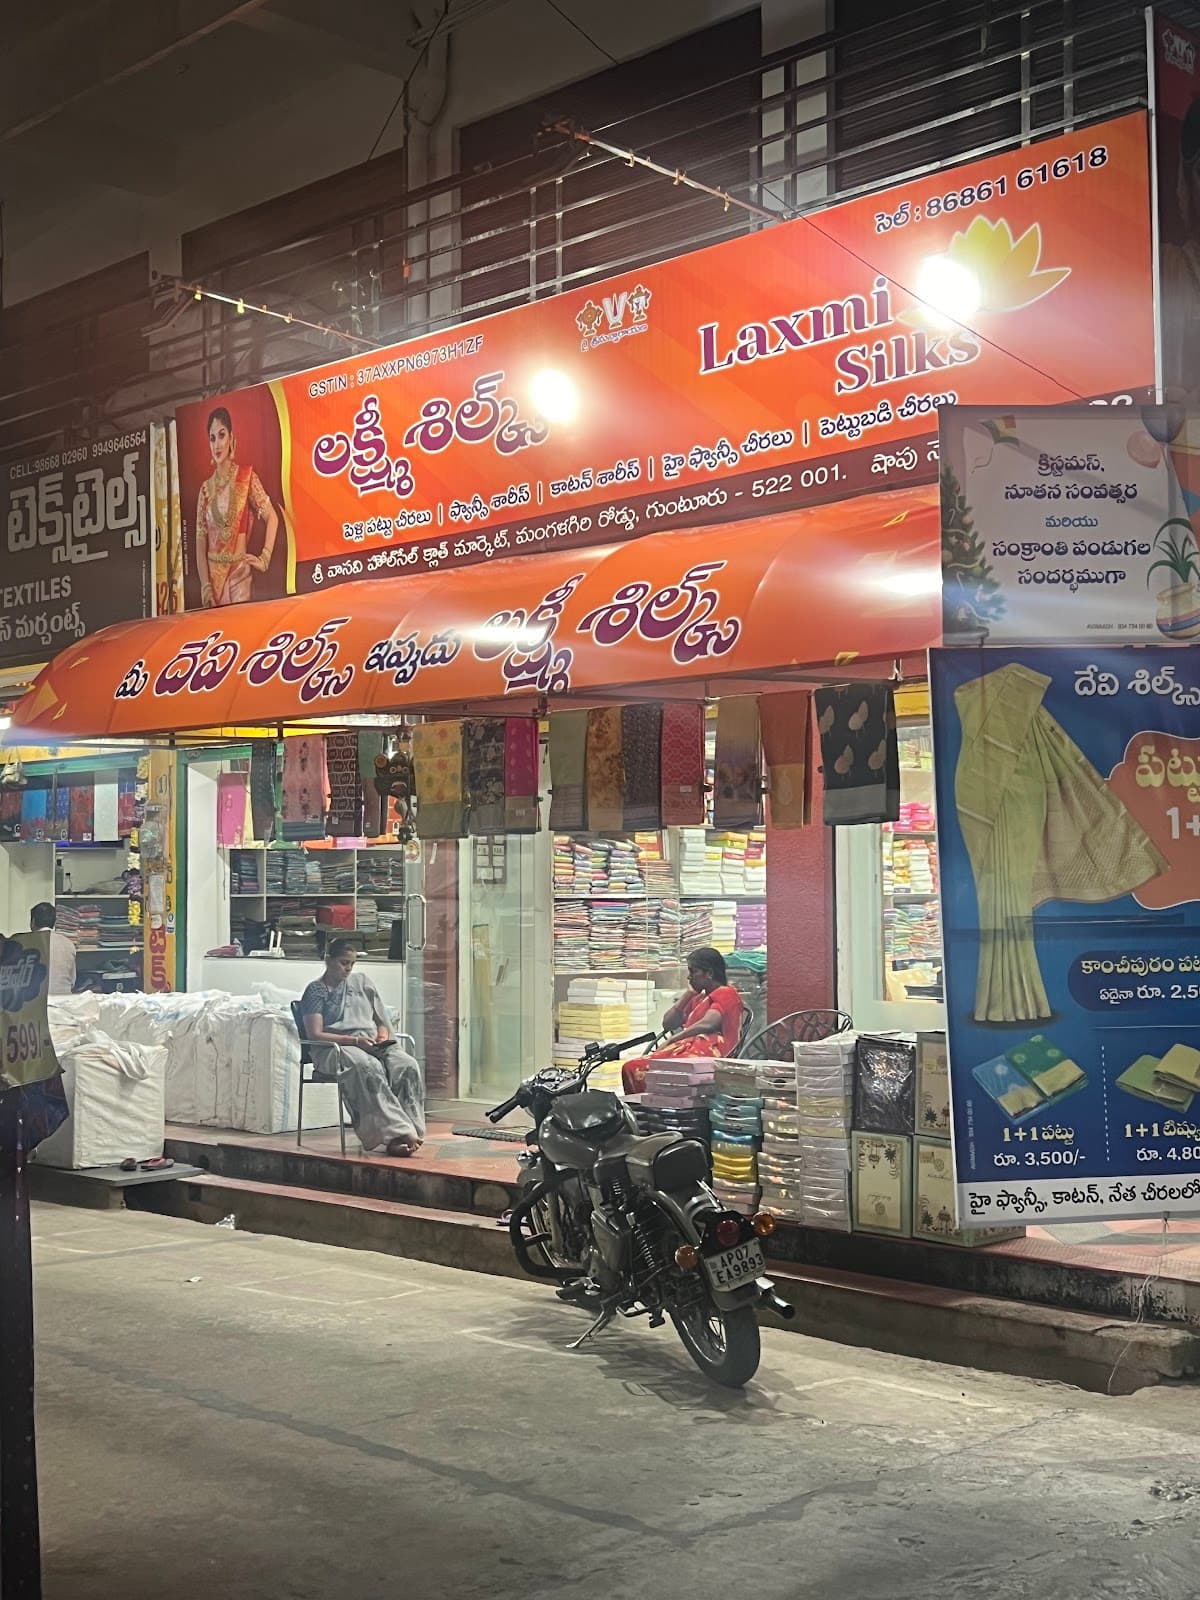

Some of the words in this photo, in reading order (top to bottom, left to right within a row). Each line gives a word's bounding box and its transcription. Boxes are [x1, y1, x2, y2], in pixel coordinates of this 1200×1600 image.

[875, 203, 913, 234] సెల్
[925, 177, 1007, 220] 86861
[1017, 146, 1108, 191] 61618
[699, 276, 896, 376] Laxmi
[309, 375, 347, 397] GSTIN
[358, 336, 484, 385] 37AXXPN6973H1ZF
[835, 327, 981, 394] Silks
[62, 447, 87, 465] 02960
[92, 430, 146, 457] 9949646564
[367, 518, 392, 537] పట్టు
[396, 511, 431, 528] చీరలు
[450, 496, 488, 520] ఫ్యాన్సీ
[492, 486, 530, 508] శారీస్
[551, 470, 592, 495] కాటన్
[597, 460, 639, 484] శారీస్
[664, 456, 684, 477] హై
[690, 440, 738, 468] ఫ్యాన్సీ
[742, 432, 792, 453] చీరలు
[820, 402, 892, 437] పెట్టుబడి
[1005, 484, 1061, 499] నూతన
[1066, 483, 1137, 503] సంవత్సర
[312, 563, 323, 584] శ్రీ
[328, 560, 363, 578] వాసవి
[423, 542, 448, 568] క్లాత్
[516, 516, 591, 544] మంగళగిరి
[646, 488, 727, 519] గుంటూరు
[752, 475, 792, 498] 522
[801, 464, 847, 488] 001.
[871, 446, 917, 474] షాపు
[1045, 515, 1098, 528] మరియు
[992, 540, 1068, 561] సంక్రాంతి
[1072, 539, 1151, 556] పండుగల
[1018, 568, 1126, 593] సందర్భముగా
[154, 631, 238, 697] దేవి
[364, 629, 461, 686] ఇప్పుడు
[1074, 664, 1119, 696] దేవి
[1081, 956, 1175, 976] కాంచీపురం
[1100, 988, 1134, 1004] ఏదైనా
[1137, 985, 1165, 999] రూ.
[1042, 1124, 1074, 1145] పట్టు
[993, 1153, 1020, 1166] రూ.
[1137, 1148, 1162, 1161] రూ.
[969, 1192, 991, 1215] హై
[996, 1187, 1048, 1213] ఫ్యాన్సీ,
[1052, 1184, 1104, 1204] కాటన్,
[1108, 1182, 1136, 1202] నేత
[716, 1253, 763, 1284] EA9893
[720, 1245, 749, 1268] AP07
